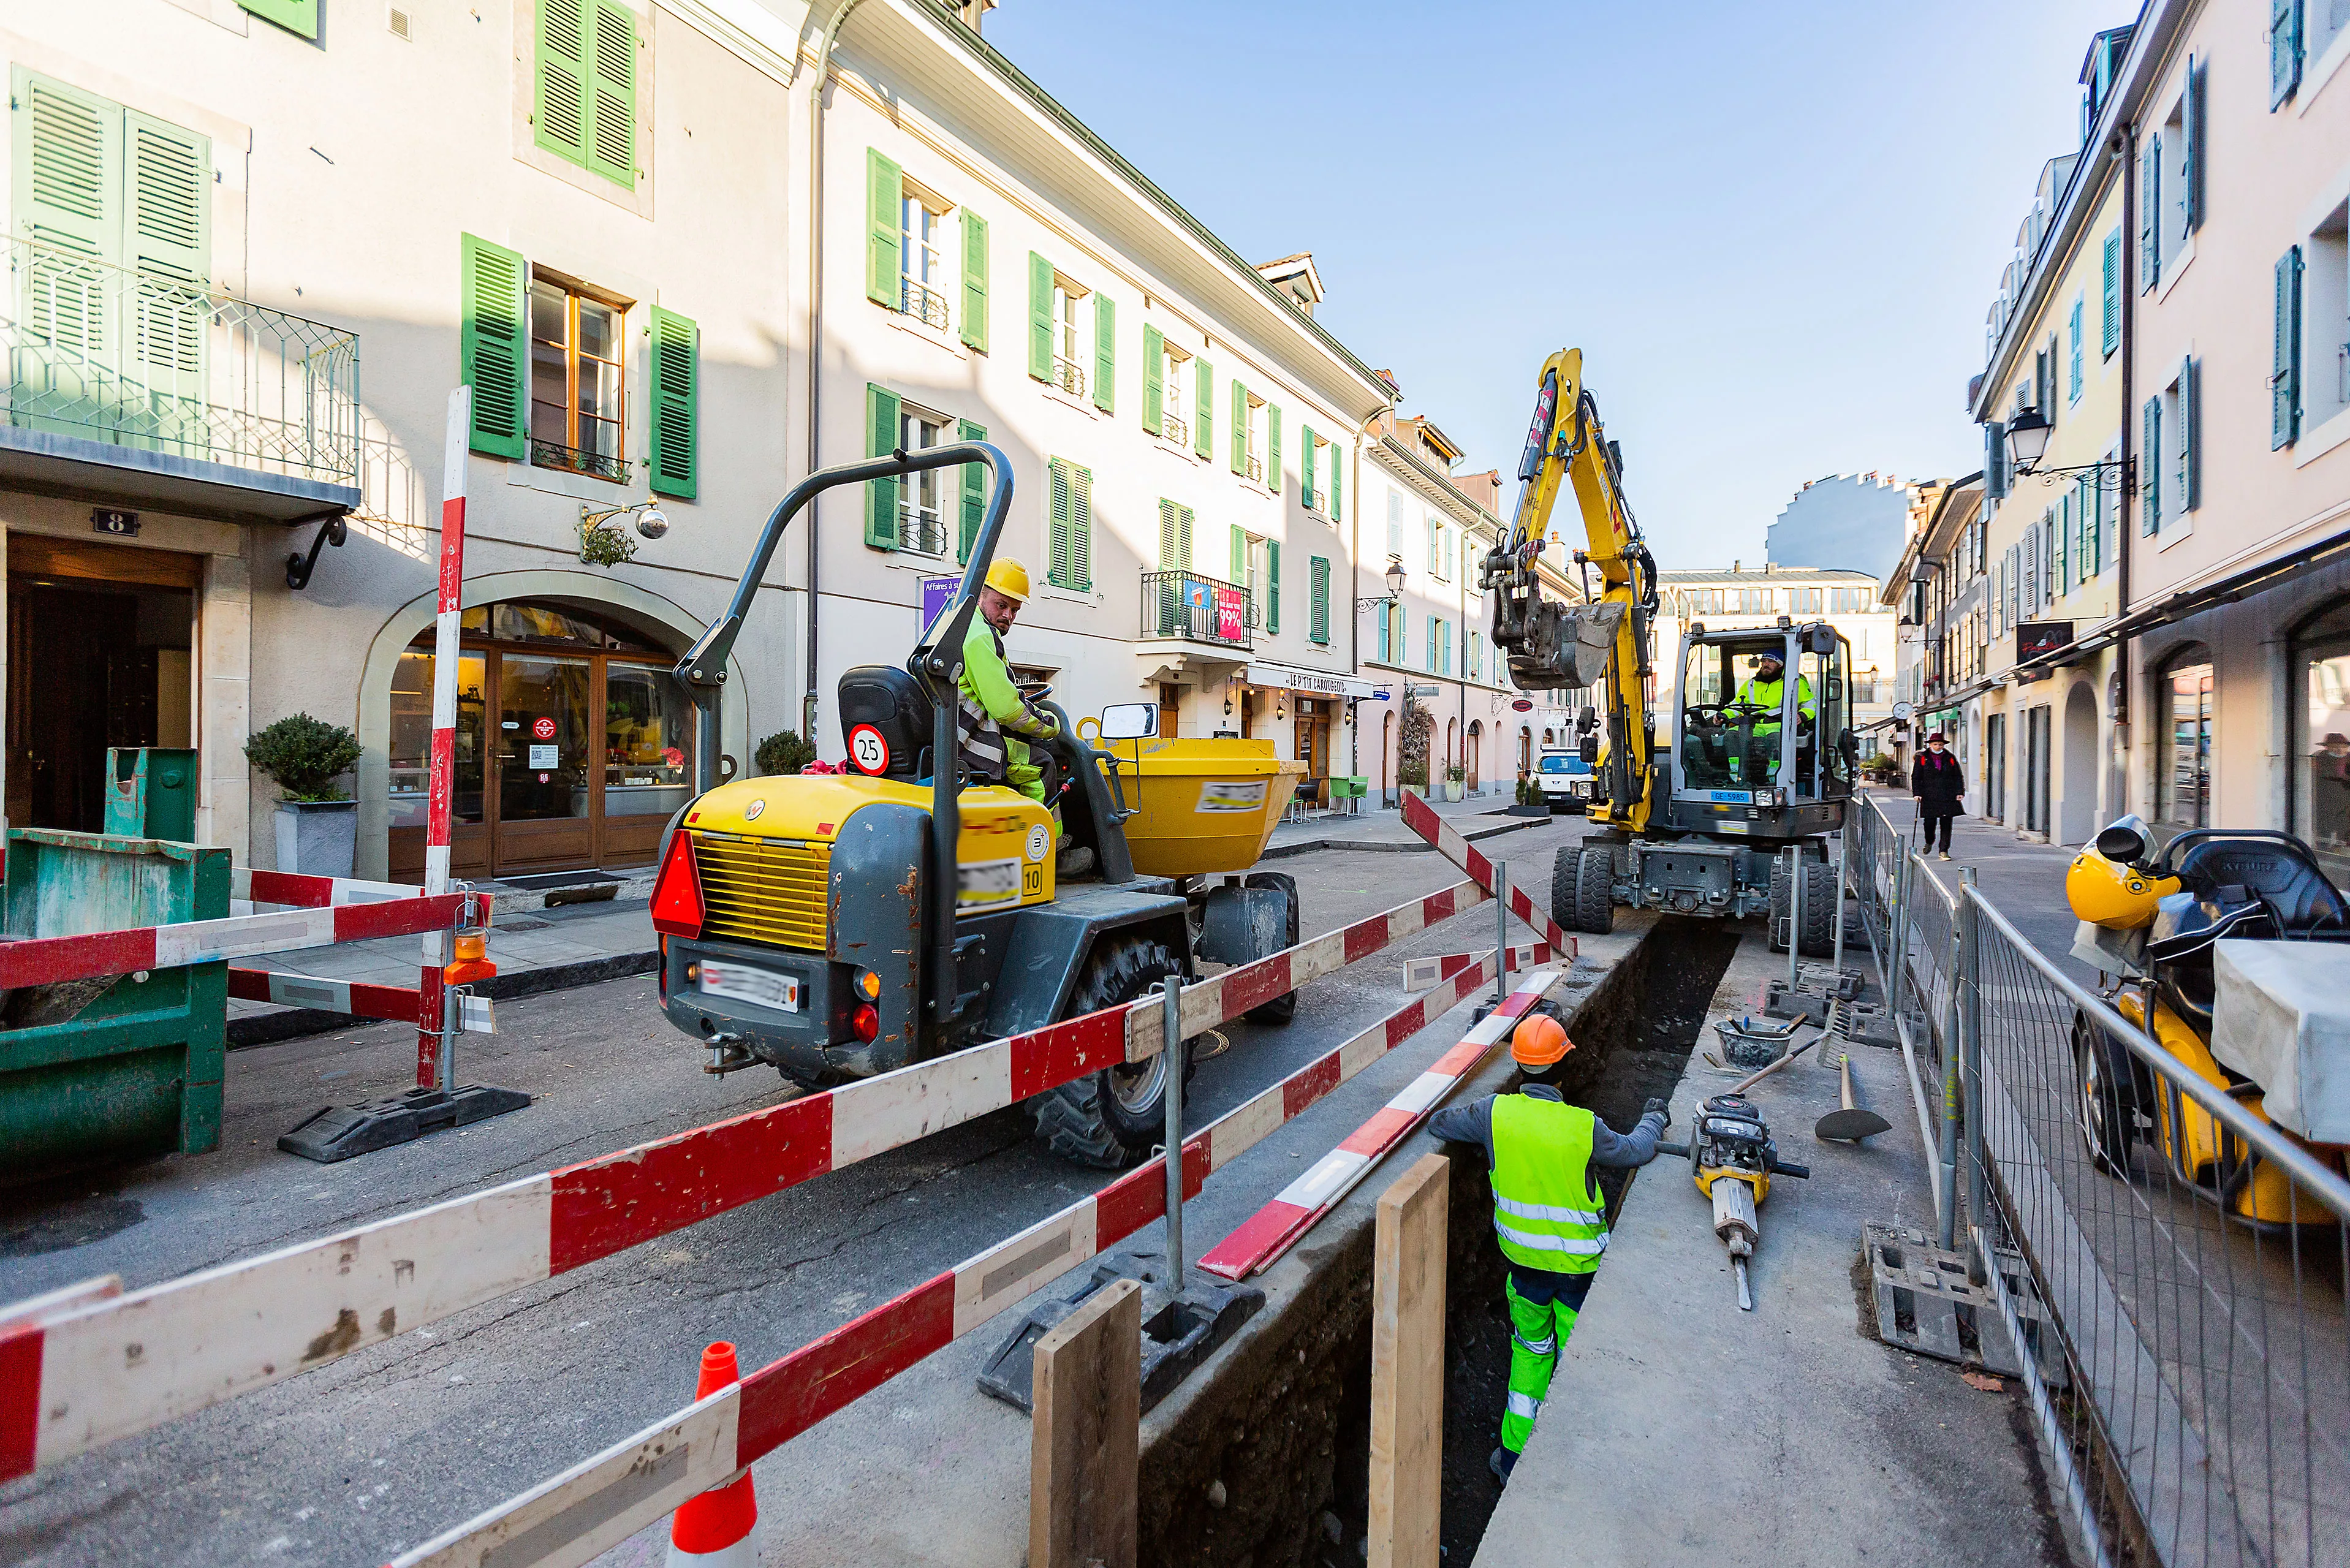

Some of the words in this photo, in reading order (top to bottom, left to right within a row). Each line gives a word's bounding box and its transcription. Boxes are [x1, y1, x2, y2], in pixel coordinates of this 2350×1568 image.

[108, 513, 124, 532] 8
[925, 582, 947, 591] Affaires
[948, 580, 953, 589] à
[1219, 608, 1241, 628] 99%
[1291, 673, 1297, 687] LE
[859, 739, 879, 761] 25
[1025, 870, 1040, 889] 10
